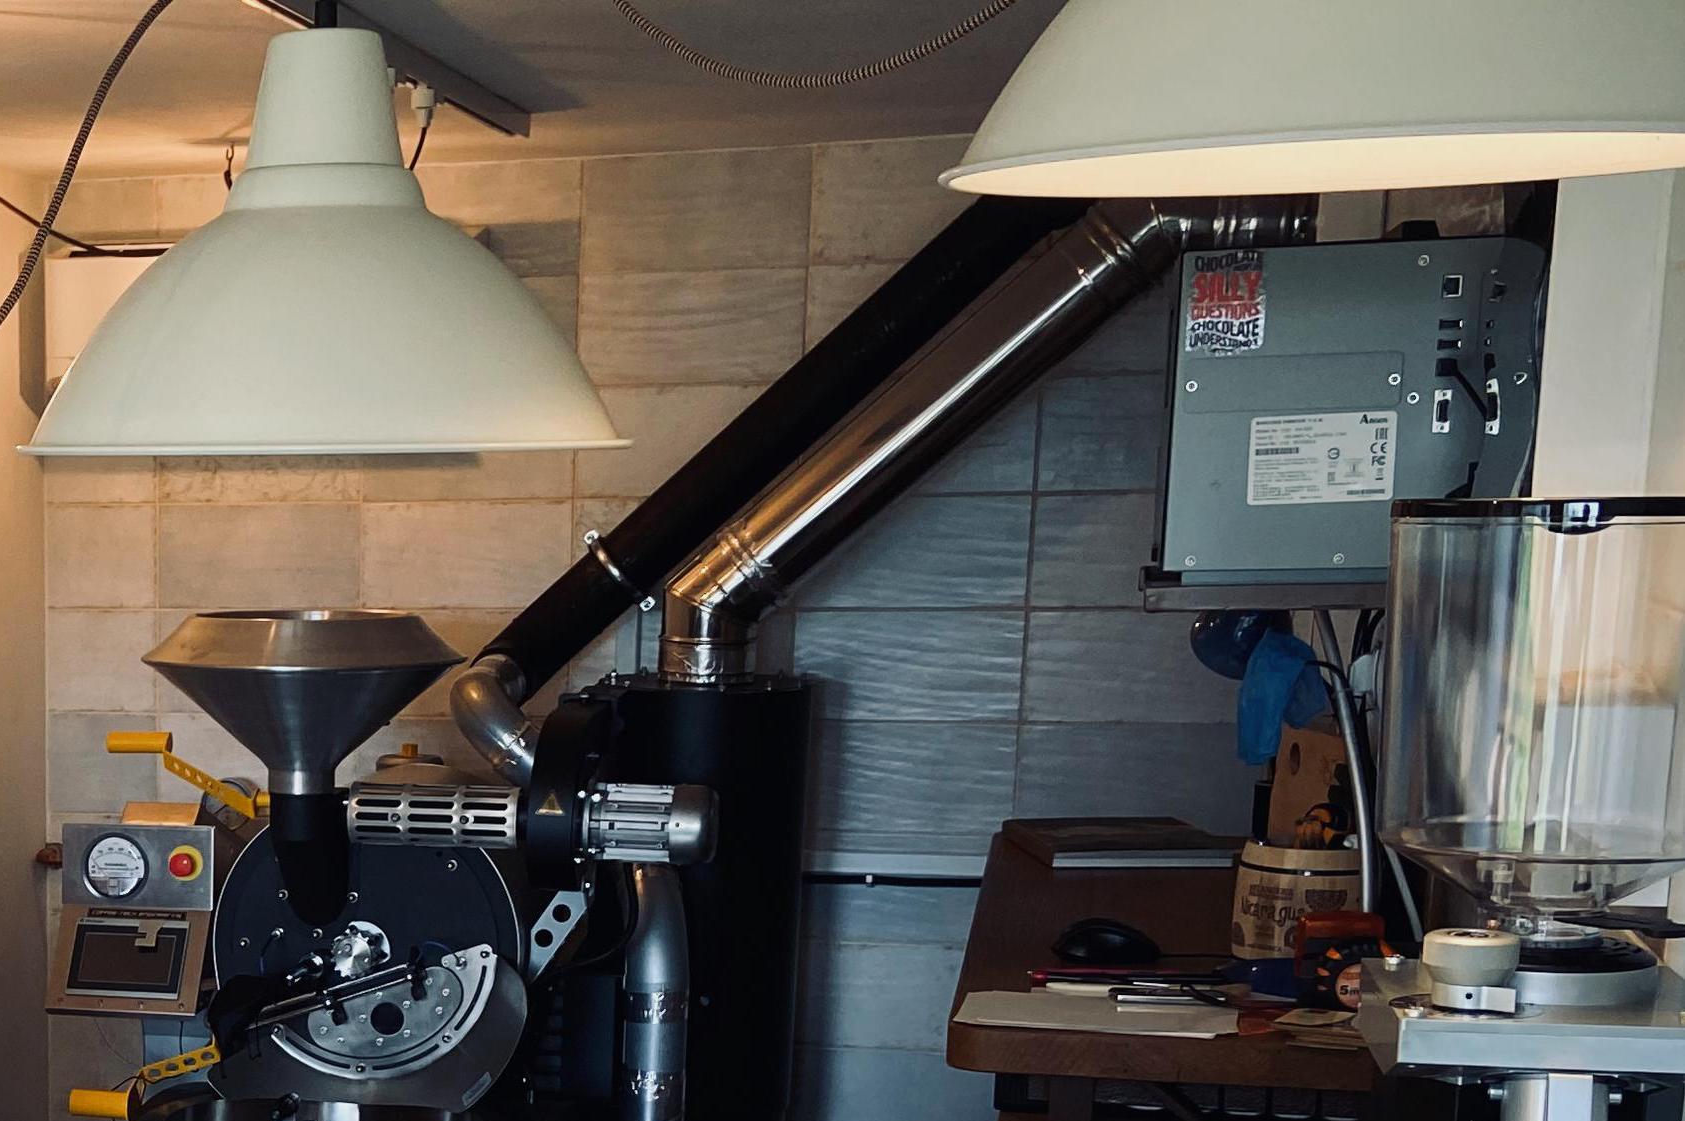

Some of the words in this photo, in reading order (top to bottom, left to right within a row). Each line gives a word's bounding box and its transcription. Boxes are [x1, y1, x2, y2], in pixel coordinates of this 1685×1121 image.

[1193, 271, 1262, 304] SILLY
[1190, 302, 1260, 321] QUESTIONS
[1189, 318, 1260, 338] CHOCOLATE
